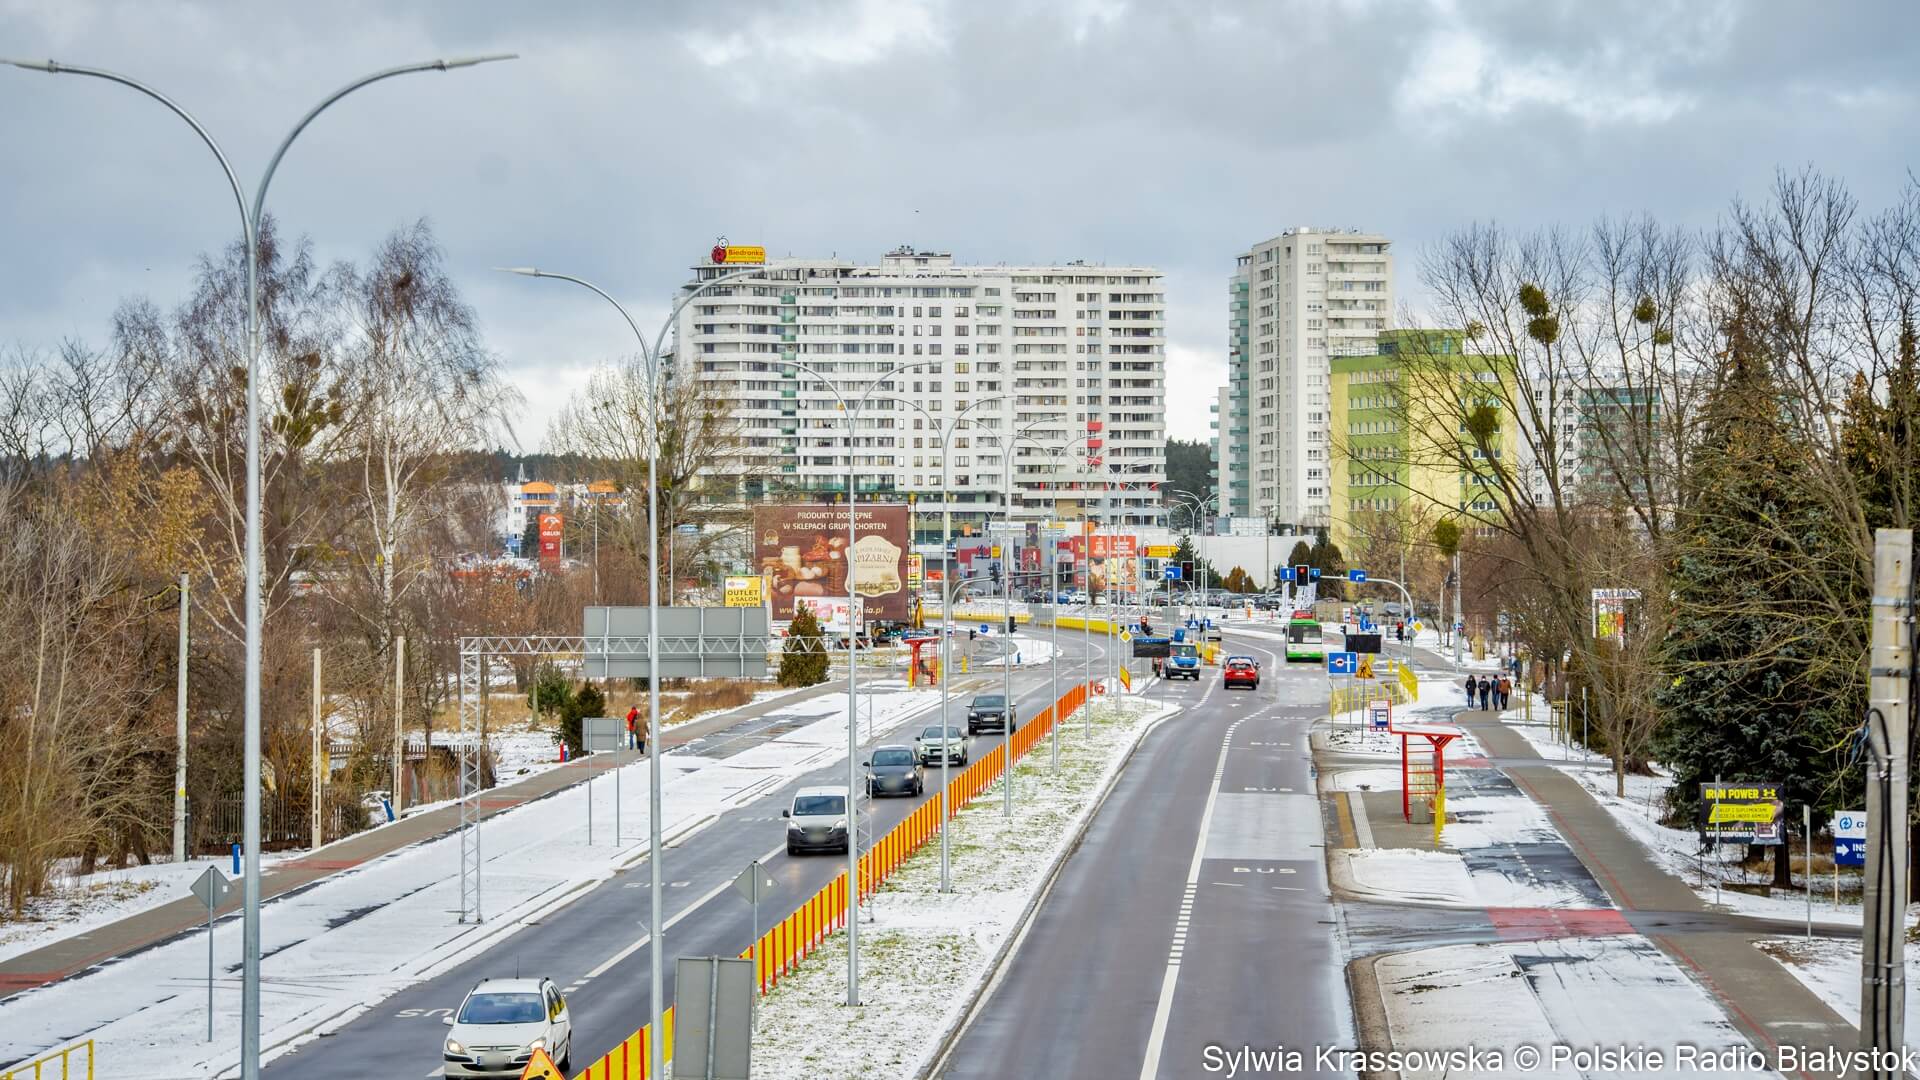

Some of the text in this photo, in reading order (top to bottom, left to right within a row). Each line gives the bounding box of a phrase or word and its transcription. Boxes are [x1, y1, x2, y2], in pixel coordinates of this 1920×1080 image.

[797, 511, 873, 521] PRODUKTY DOSĘPNE
[782, 522, 791, 530] W
[792, 522, 827, 530] SKLEPACH
[854, 522, 887, 530] CHORTEN
[1728, 788, 1759, 799] POWER
